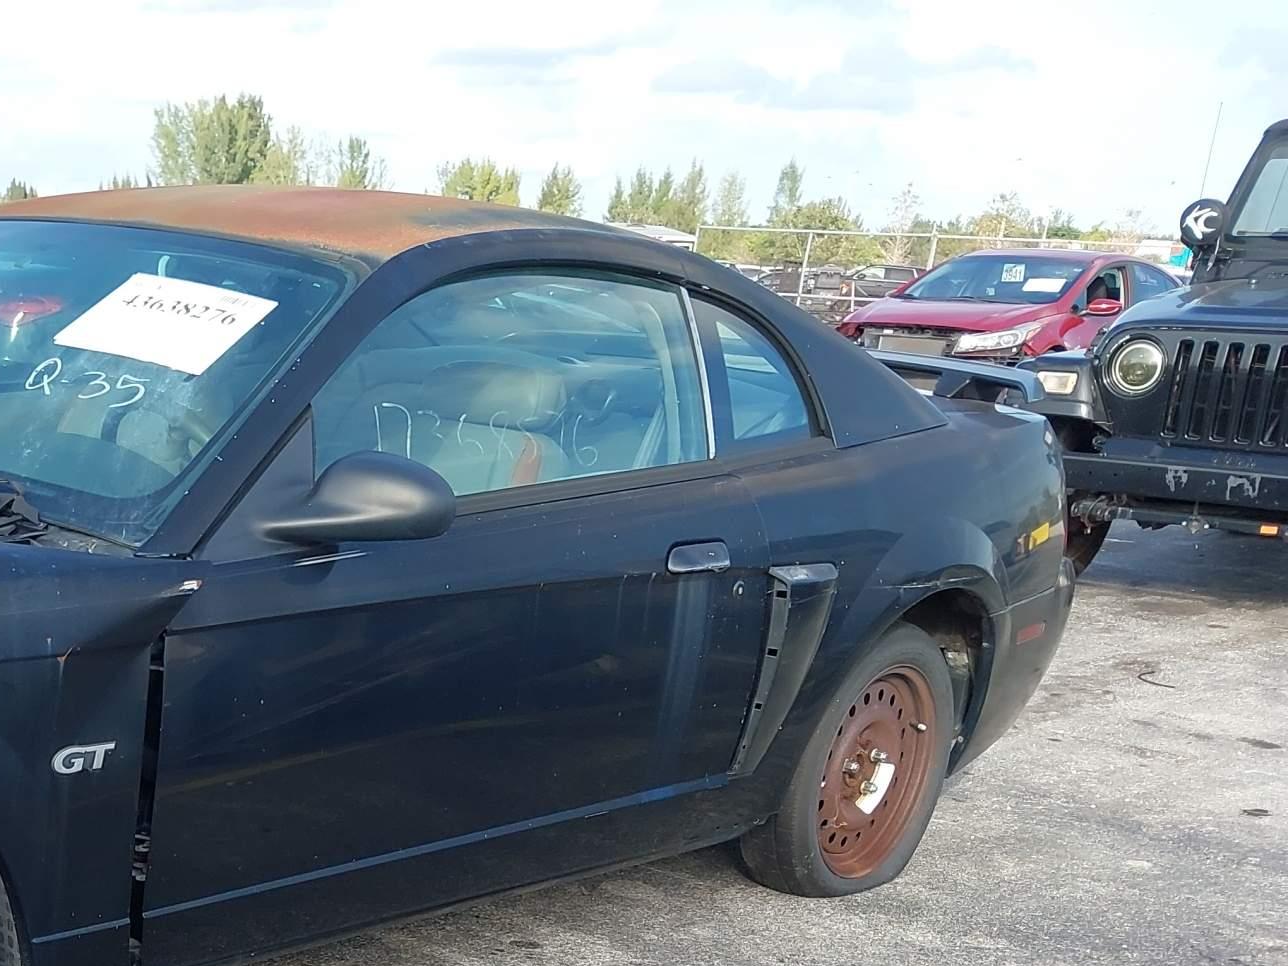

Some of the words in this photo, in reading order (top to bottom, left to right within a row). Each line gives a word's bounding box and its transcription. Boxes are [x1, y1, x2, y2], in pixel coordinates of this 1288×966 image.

[1182, 204, 1219, 240] KC
[122, 294, 238, 325] 43638276
[52, 740, 117, 775] GT
